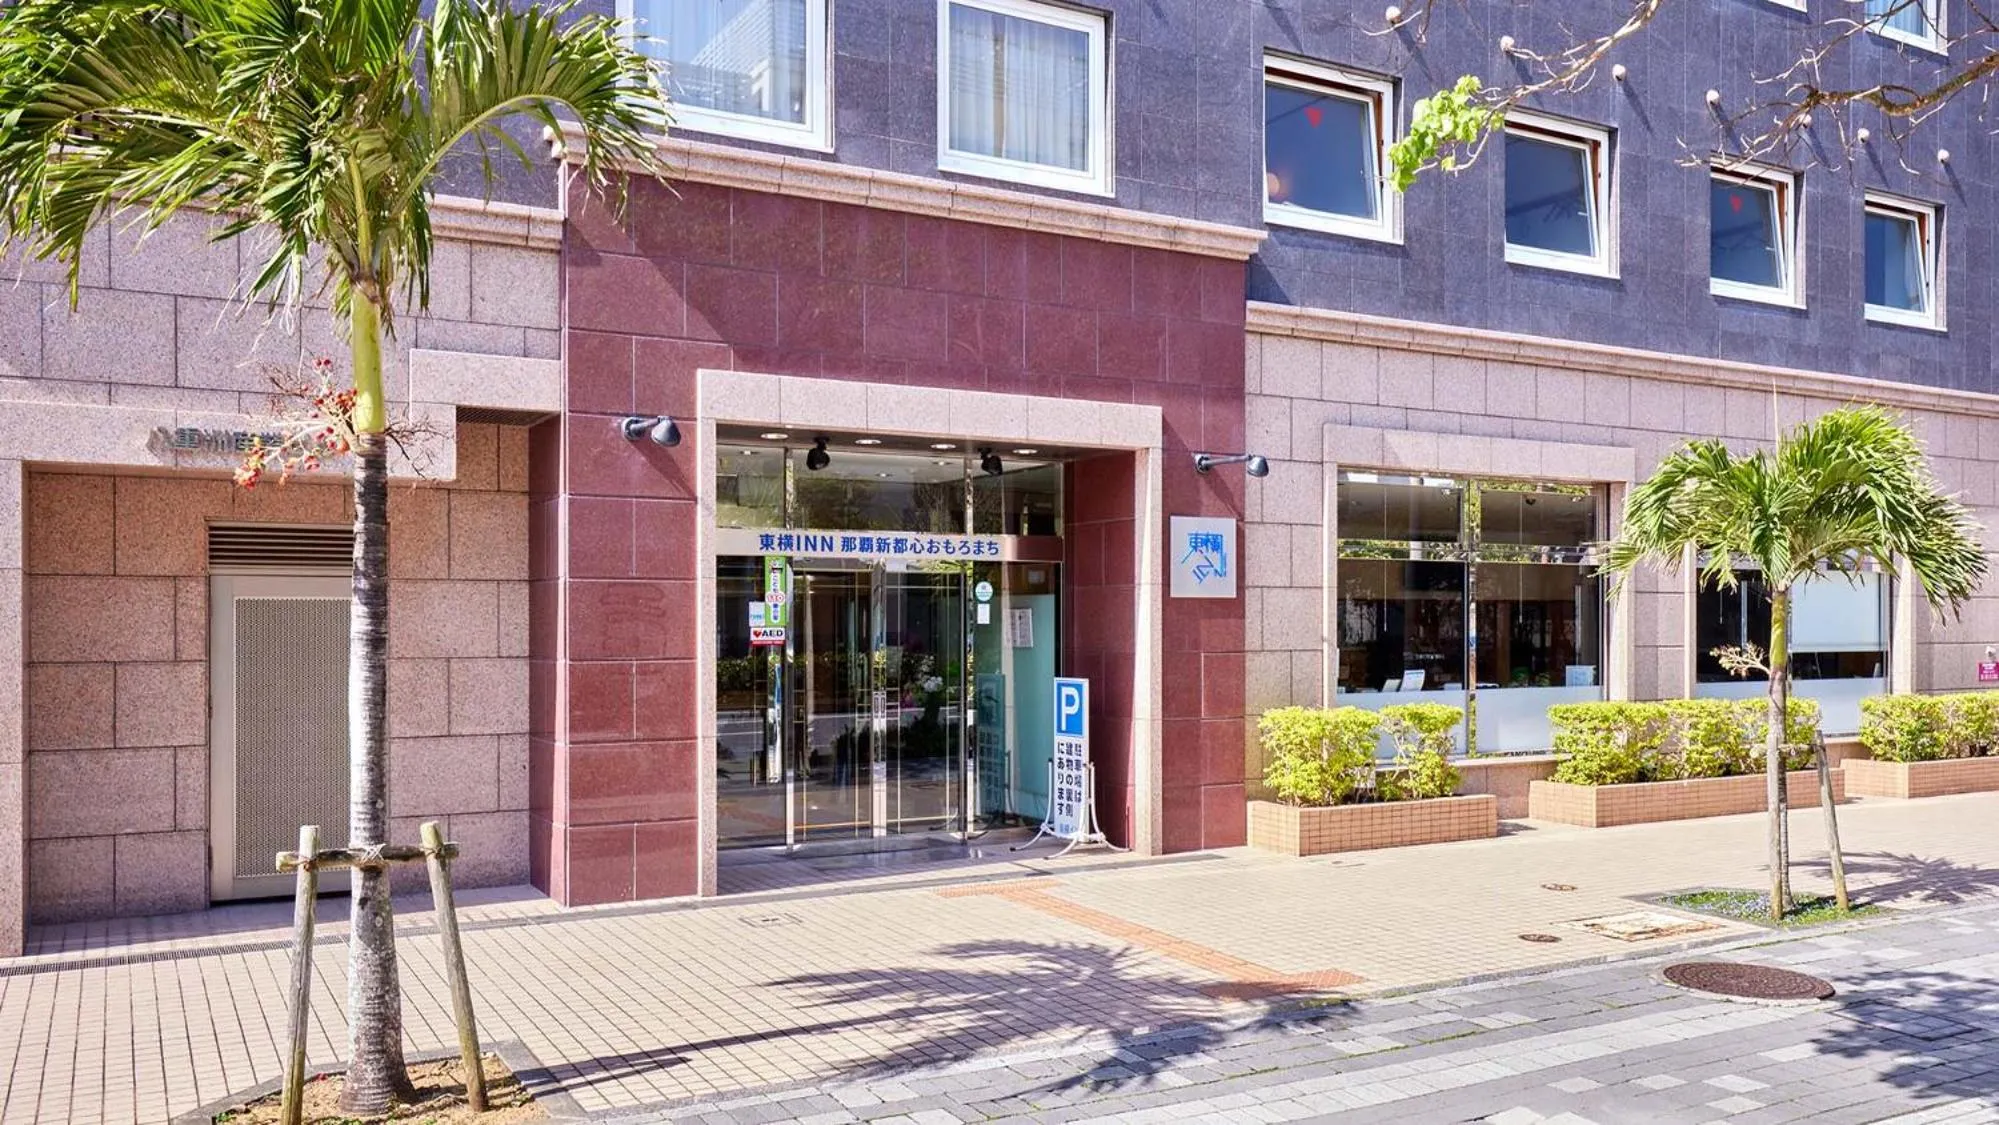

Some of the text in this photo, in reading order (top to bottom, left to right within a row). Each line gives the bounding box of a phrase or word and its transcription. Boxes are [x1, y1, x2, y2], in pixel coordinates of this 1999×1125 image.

[759, 534, 999, 555] 東横INN 那覇新都心おもろまち
[1061, 687, 1080, 732] P
[1057, 741, 1065, 815] にあります
[1065, 742, 1074, 817] 建物の裏側
[1074, 743, 1082, 803] 駐車場は
